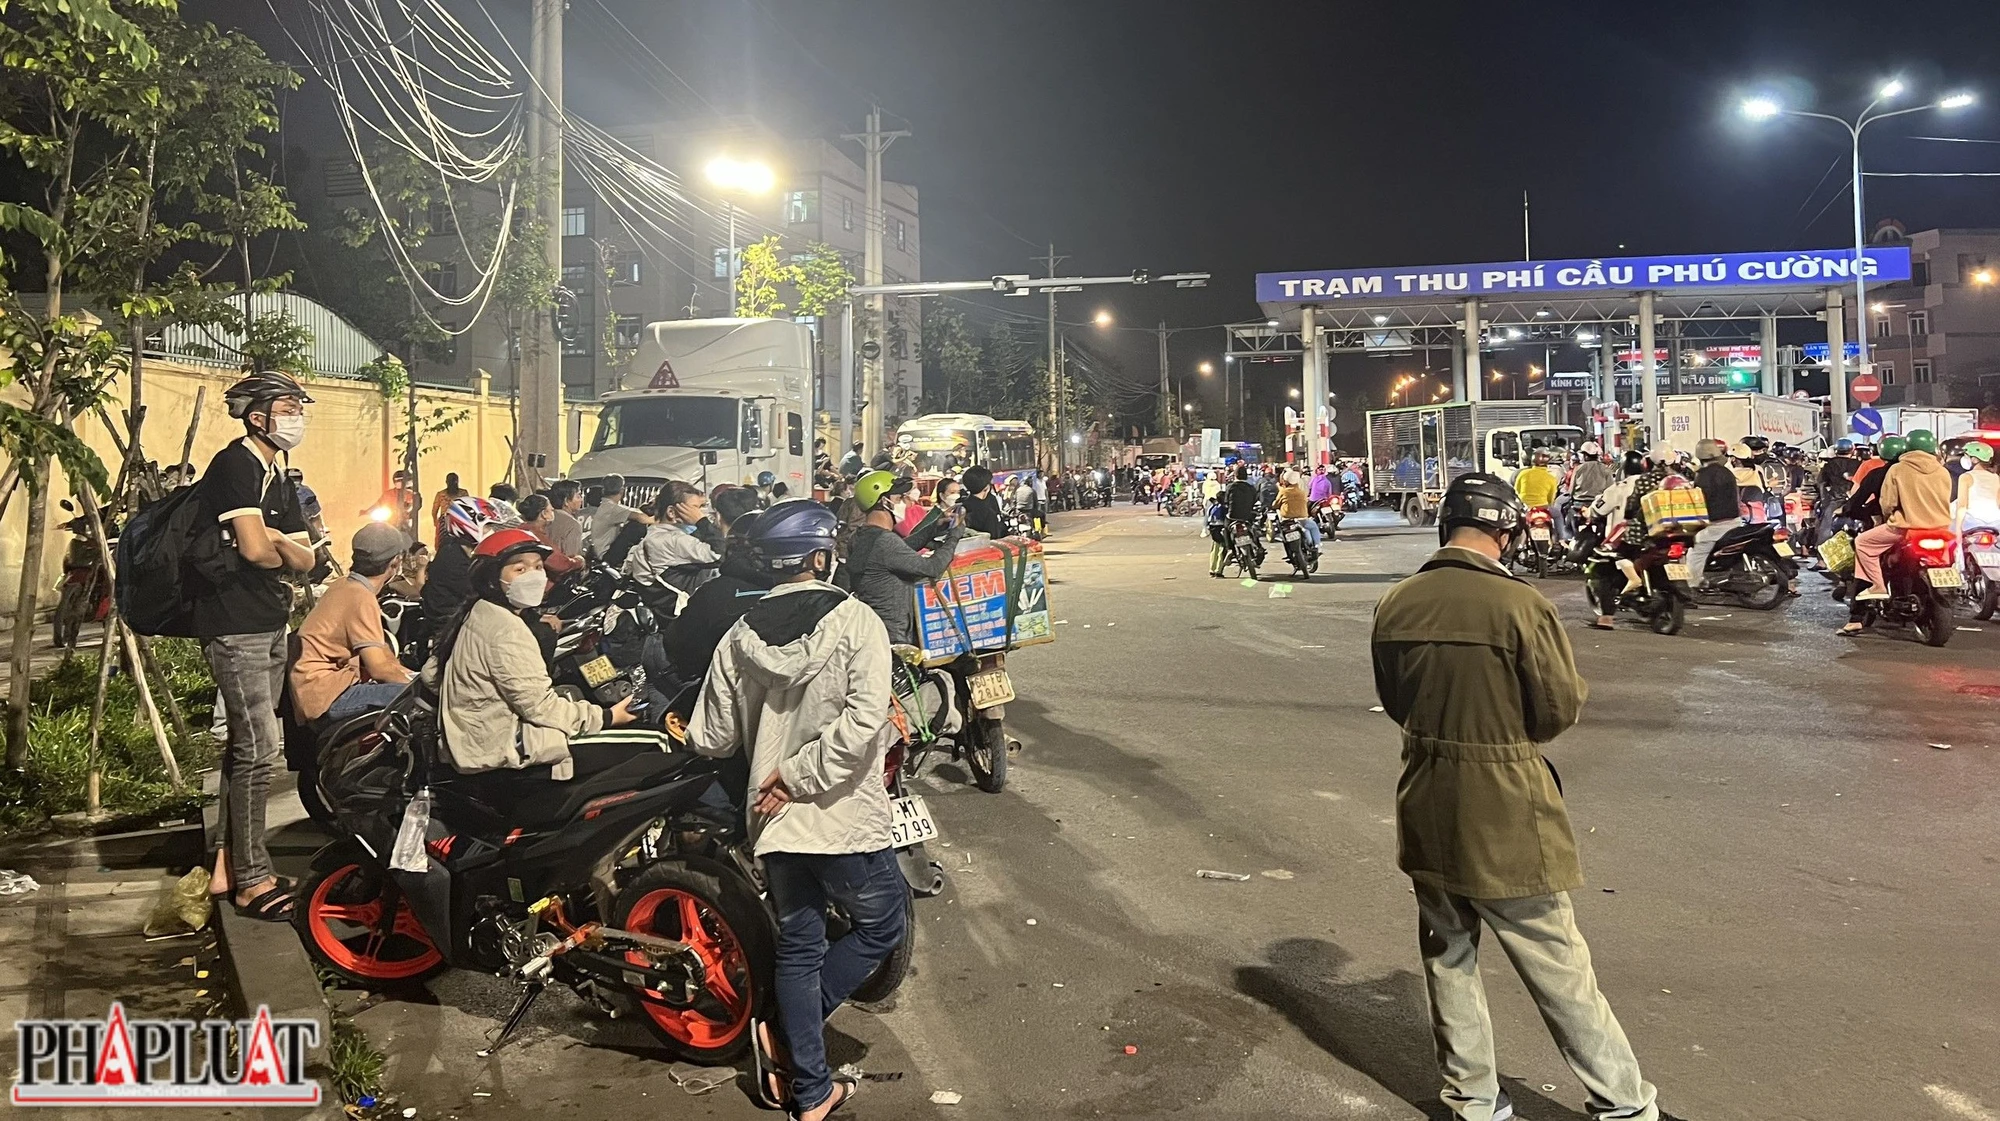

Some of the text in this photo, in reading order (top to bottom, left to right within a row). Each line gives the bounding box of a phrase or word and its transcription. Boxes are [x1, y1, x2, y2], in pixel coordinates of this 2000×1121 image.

[1279, 254, 1878, 298] TRẠM THU PHÍ CẦU PHÚ CƯỜNG
[1551, 377, 1572, 388] KÍNH
[923, 571, 1006, 609] KEM
[891, 818, 933, 844] 67.99
